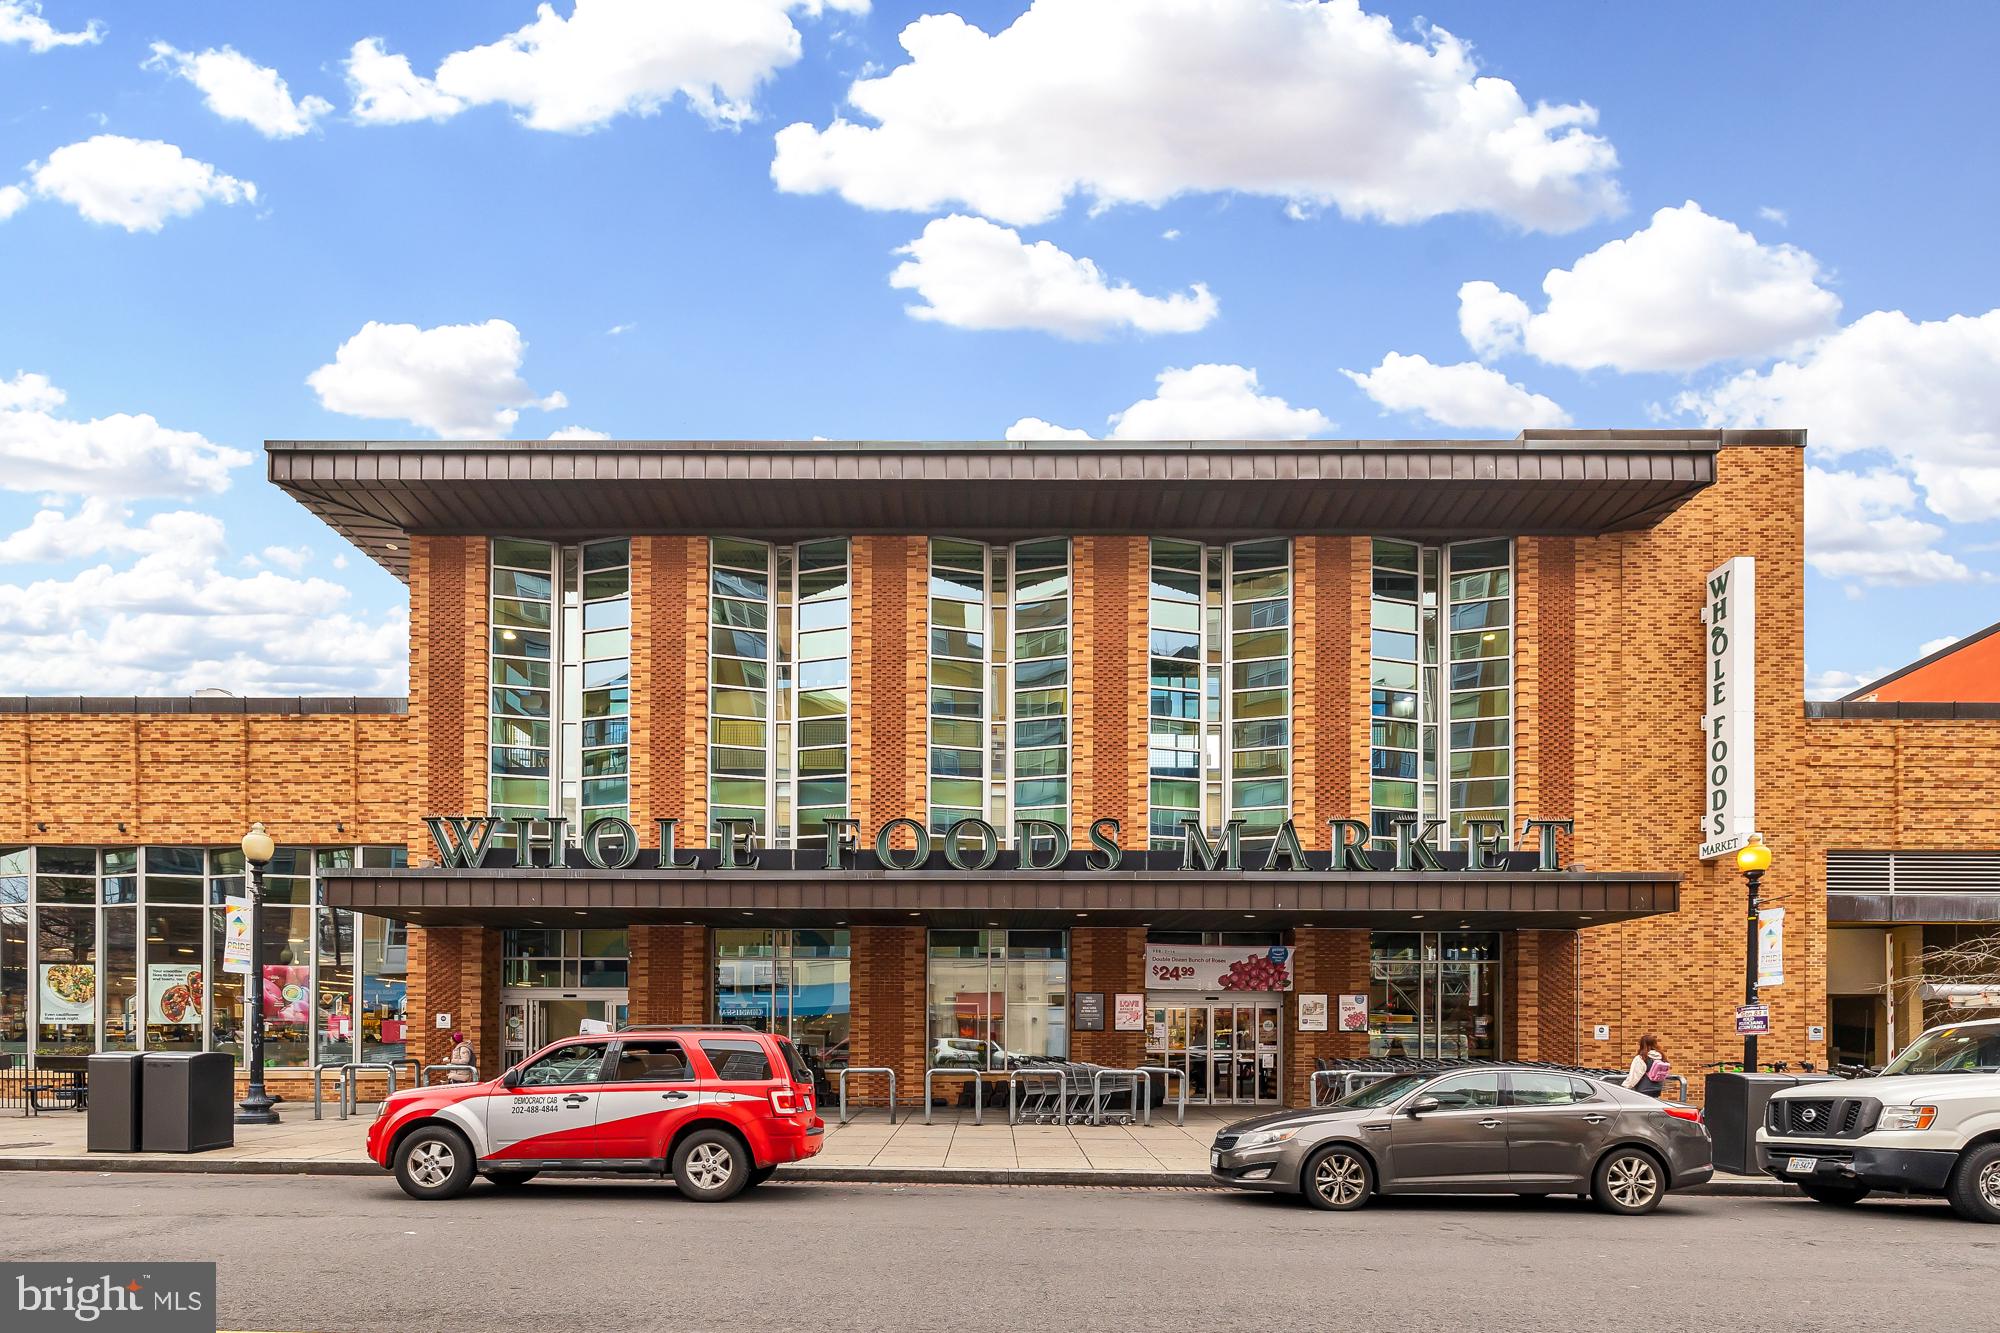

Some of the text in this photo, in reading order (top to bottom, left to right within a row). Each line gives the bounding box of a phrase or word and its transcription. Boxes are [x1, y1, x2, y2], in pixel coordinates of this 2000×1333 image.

[1709, 571, 1731, 836] WHOLE FOODS
[422, 815, 1575, 872] WHOLE FOODS MARKET
[1702, 837, 1738, 857] MARKET
[227, 941, 251, 951] PRIDE
[514, 1096, 546, 1104] DEMOCRACY
[512, 1105, 558, 1114] 202-488-4844
